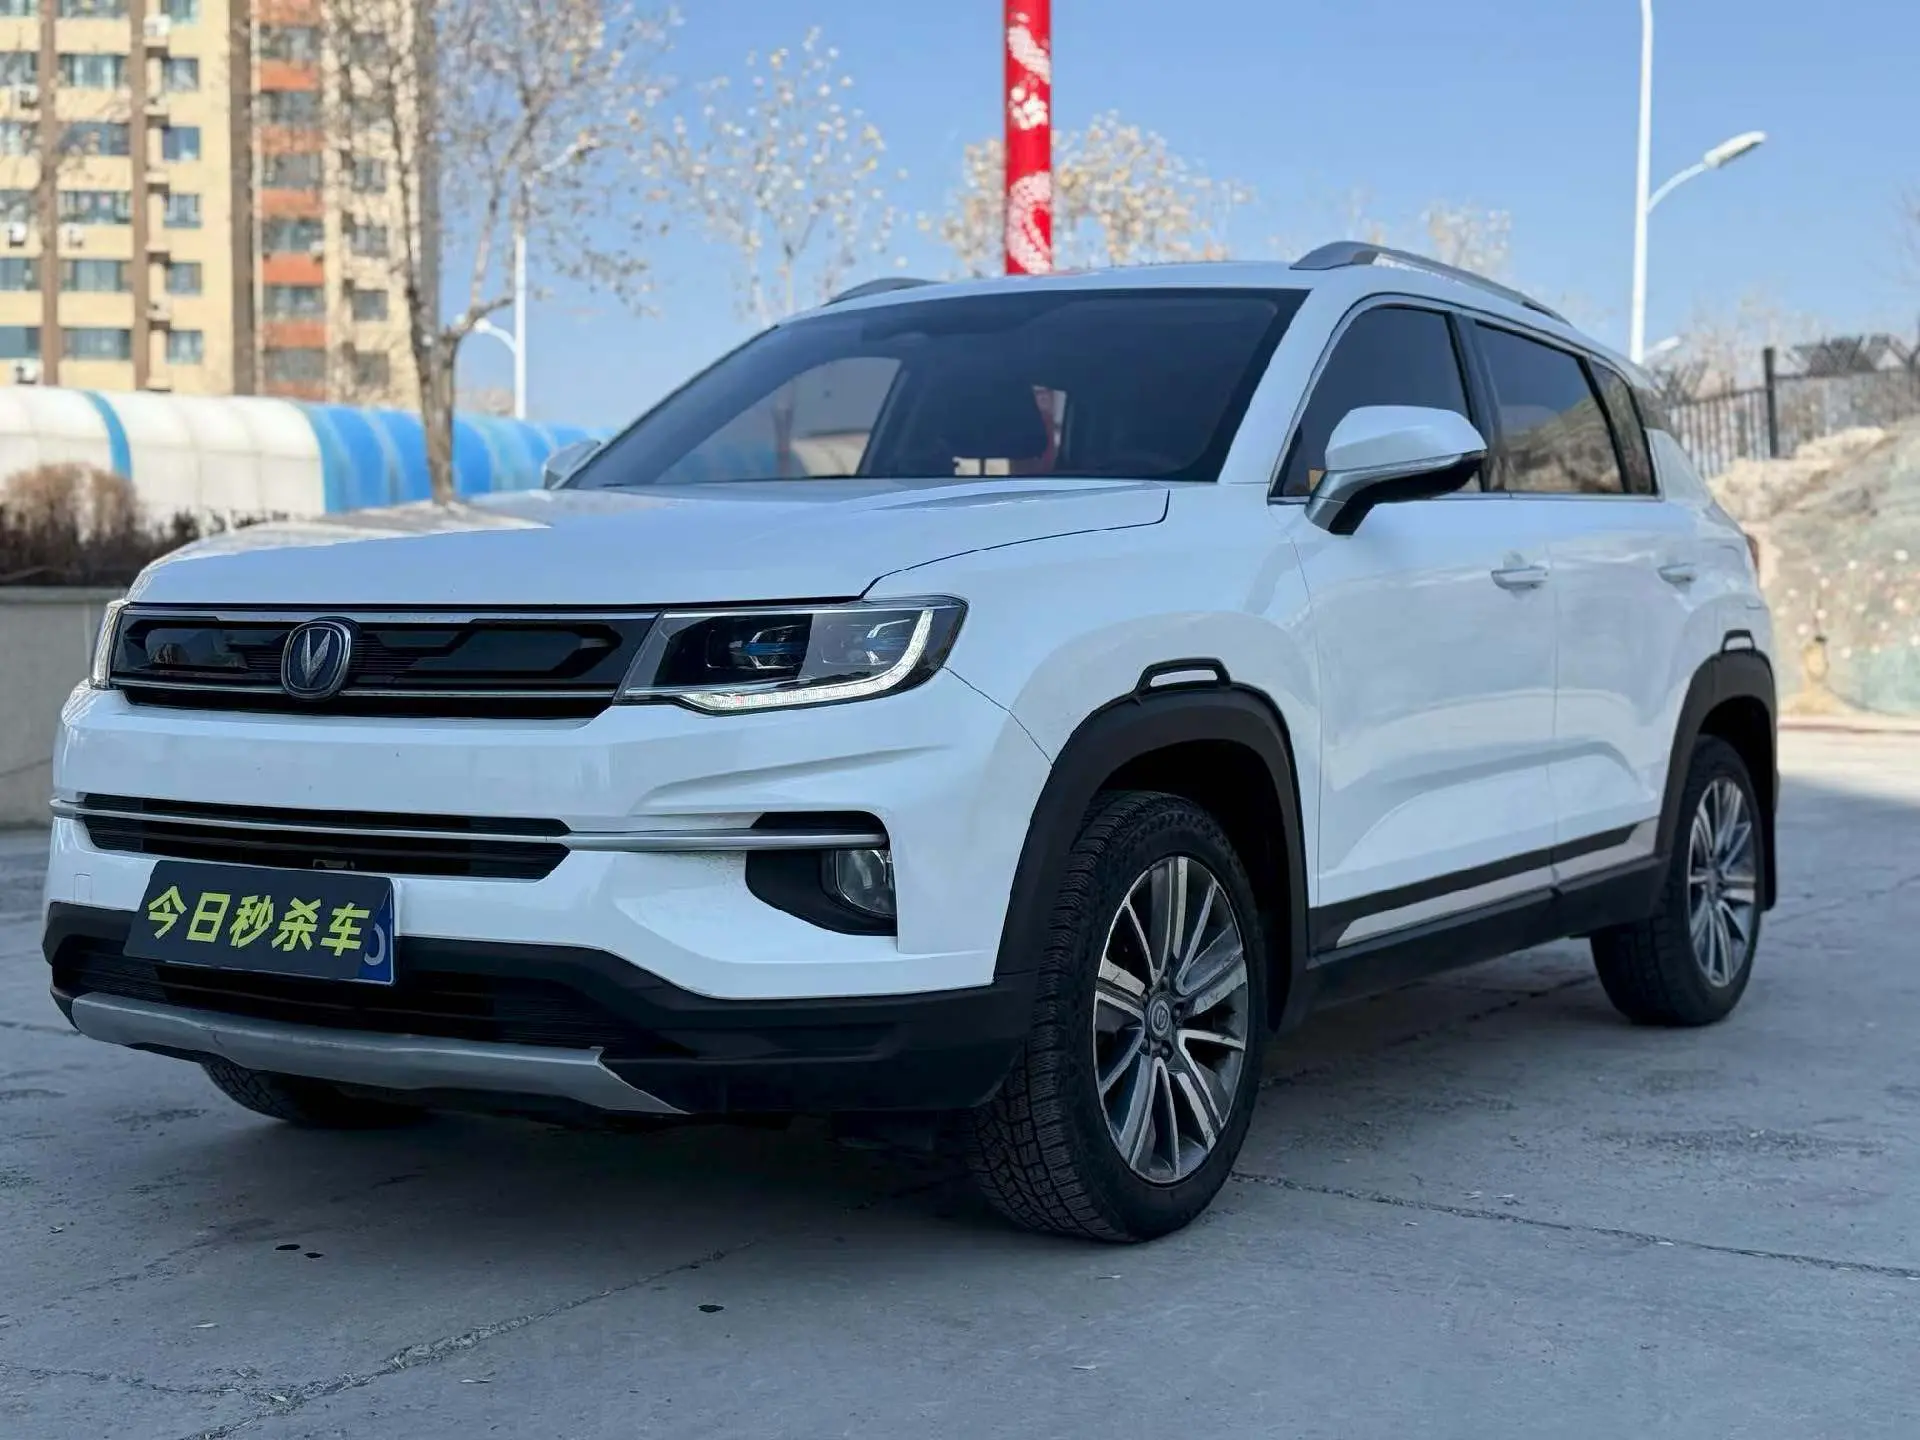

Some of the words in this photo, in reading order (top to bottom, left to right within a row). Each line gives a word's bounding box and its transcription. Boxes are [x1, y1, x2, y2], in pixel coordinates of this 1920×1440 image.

[147, 885, 371, 957] 今日秒杀车
